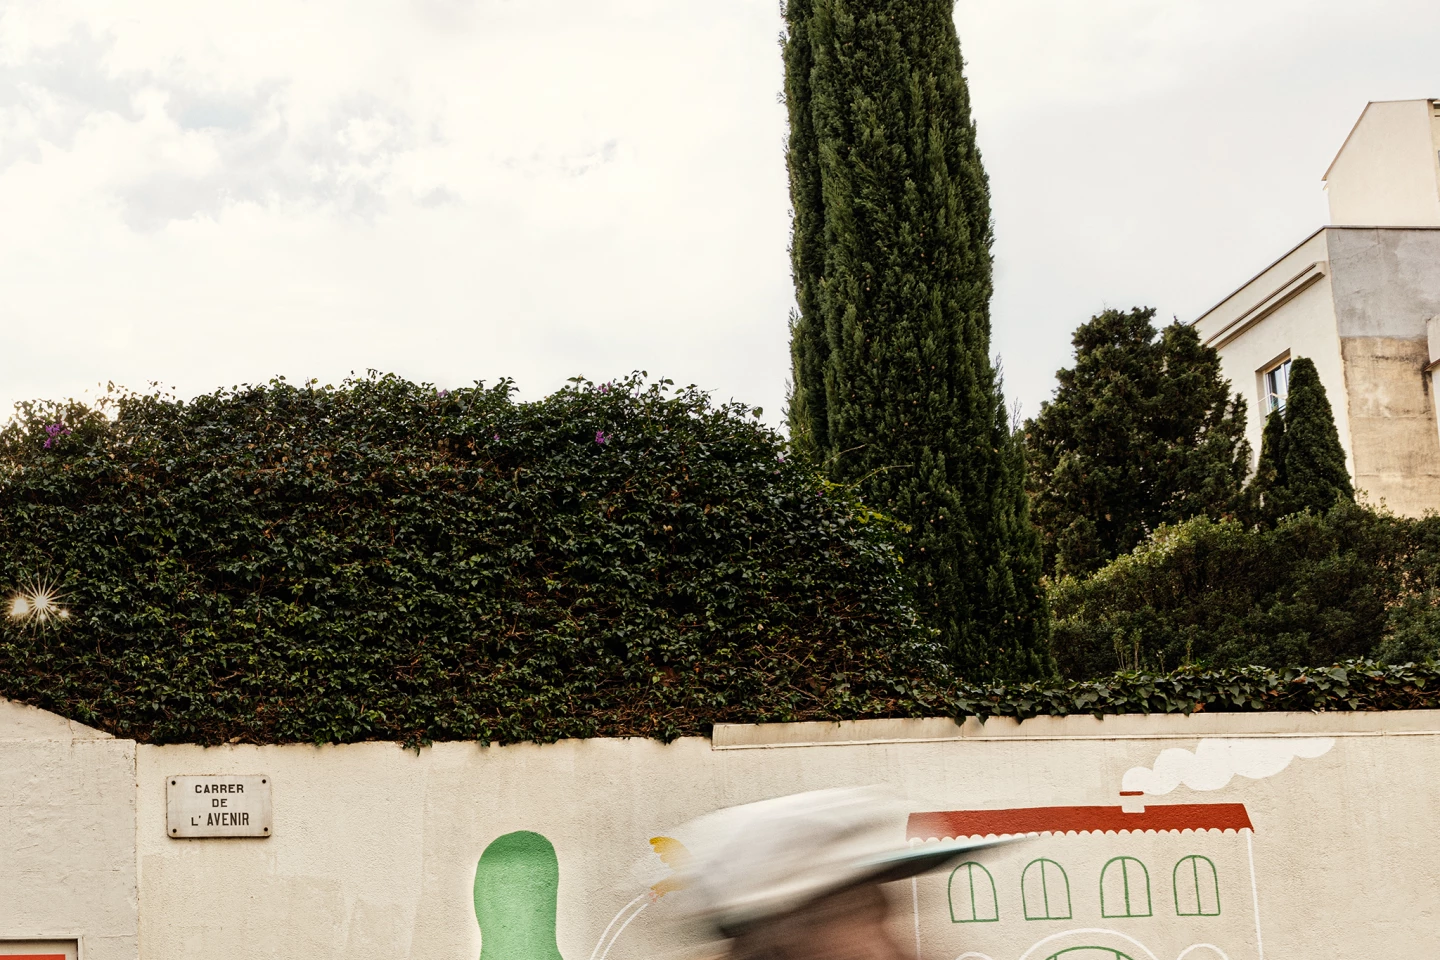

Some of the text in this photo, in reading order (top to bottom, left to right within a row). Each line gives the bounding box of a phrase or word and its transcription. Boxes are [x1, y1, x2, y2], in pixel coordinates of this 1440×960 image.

[195, 784, 244, 794] CARRER
[211, 798, 228, 808] DE
[206, 812, 250, 827] AVENIR
